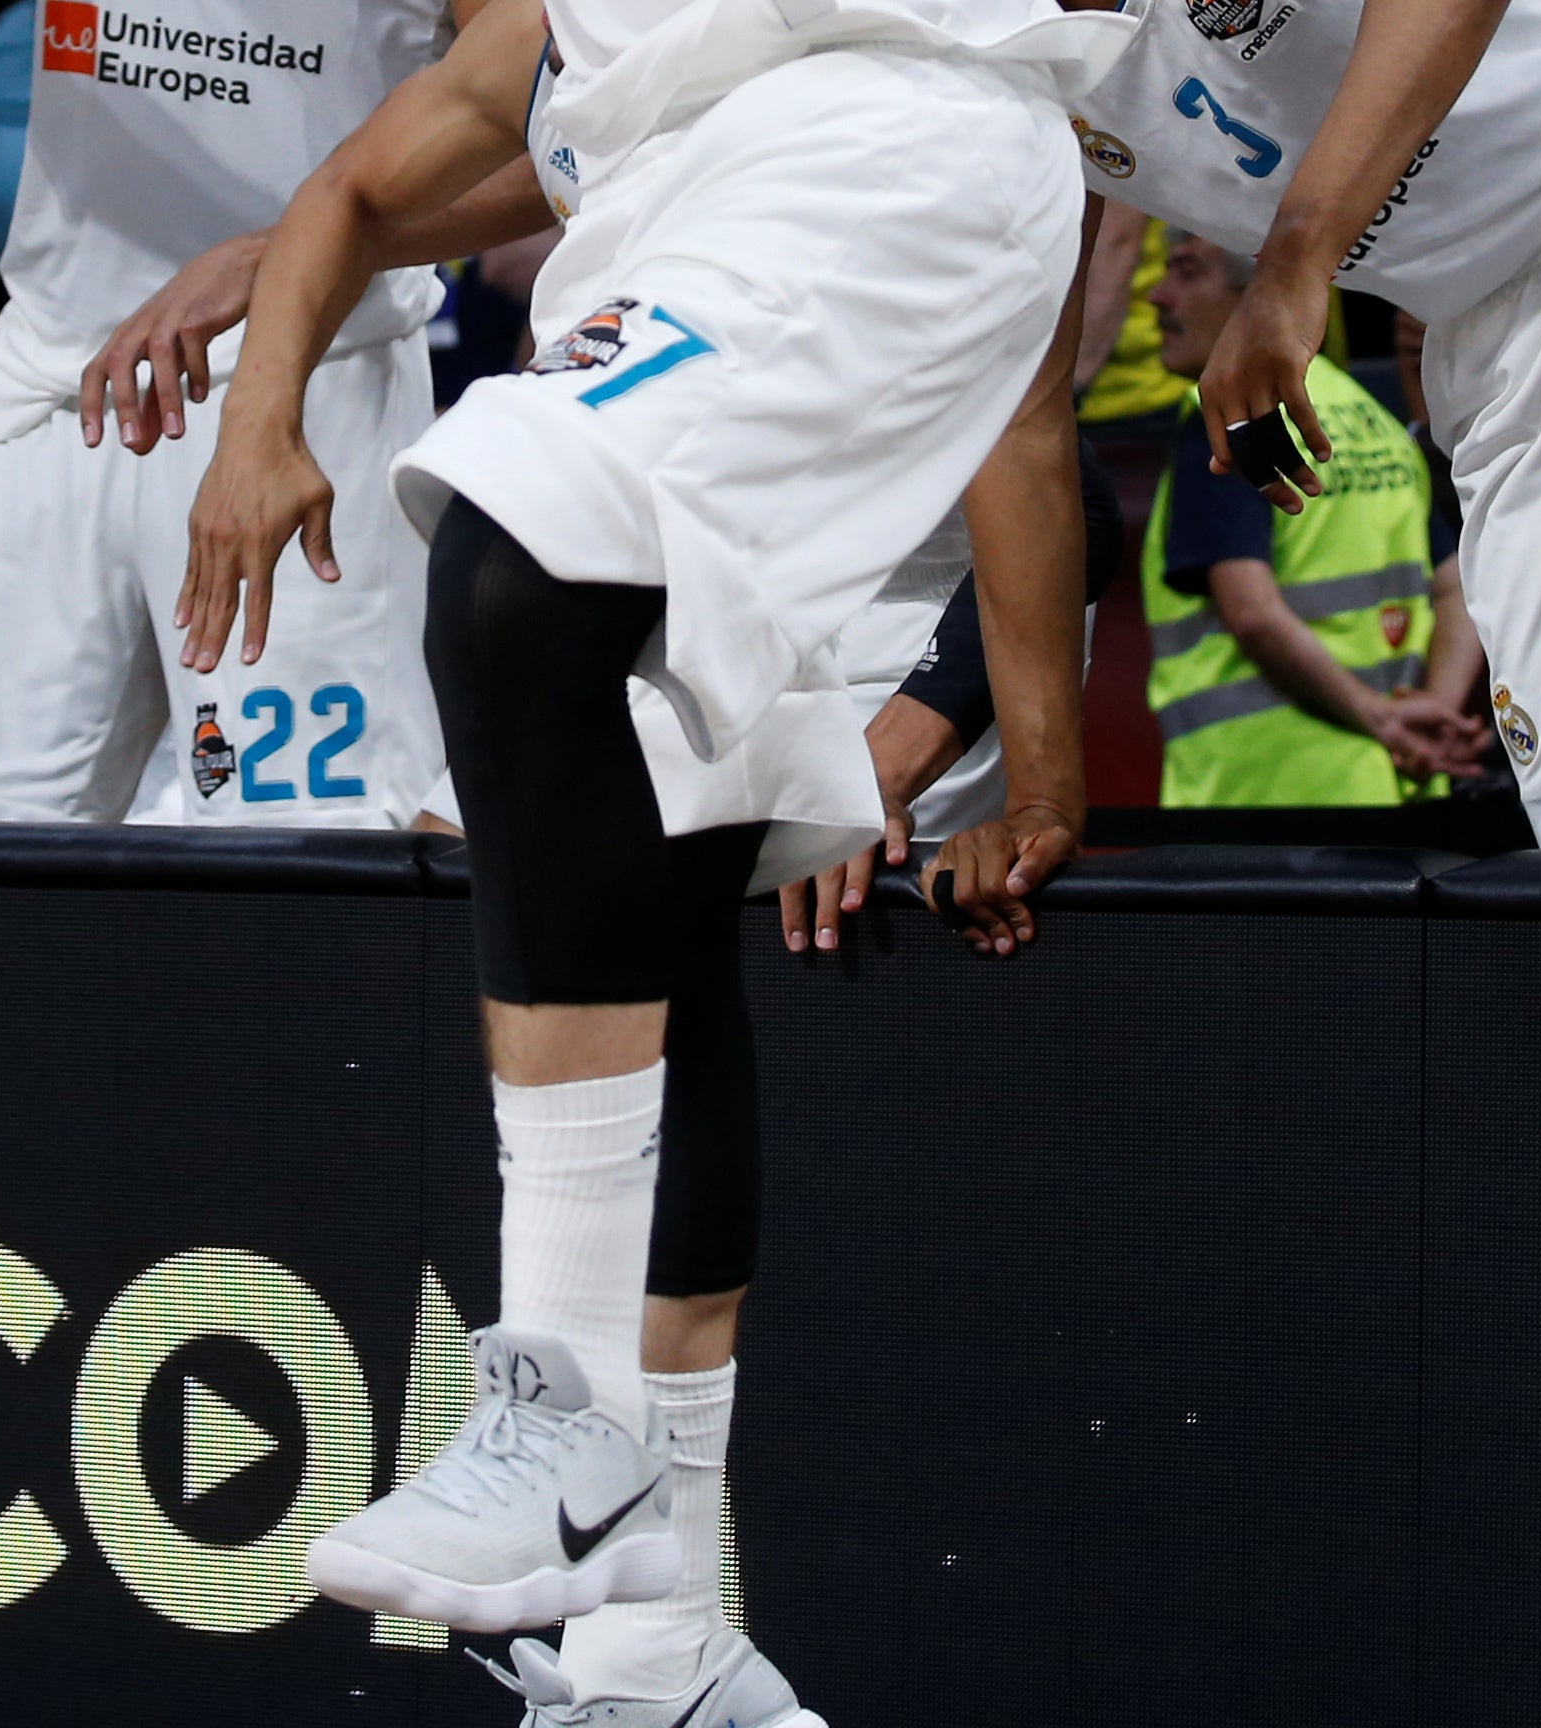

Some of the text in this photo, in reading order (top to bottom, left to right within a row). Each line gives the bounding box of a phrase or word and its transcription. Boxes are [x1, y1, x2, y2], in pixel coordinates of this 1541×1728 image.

[102, 10, 324, 74] Universidad
[1193, 0, 1228, 34] FINAL
[1240, 5, 1296, 62] oneteam
[98, 52, 250, 104] Europea
[1172, 74, 1283, 178] 3
[575, 305, 719, 410] 7
[238, 683, 367, 803] 22
